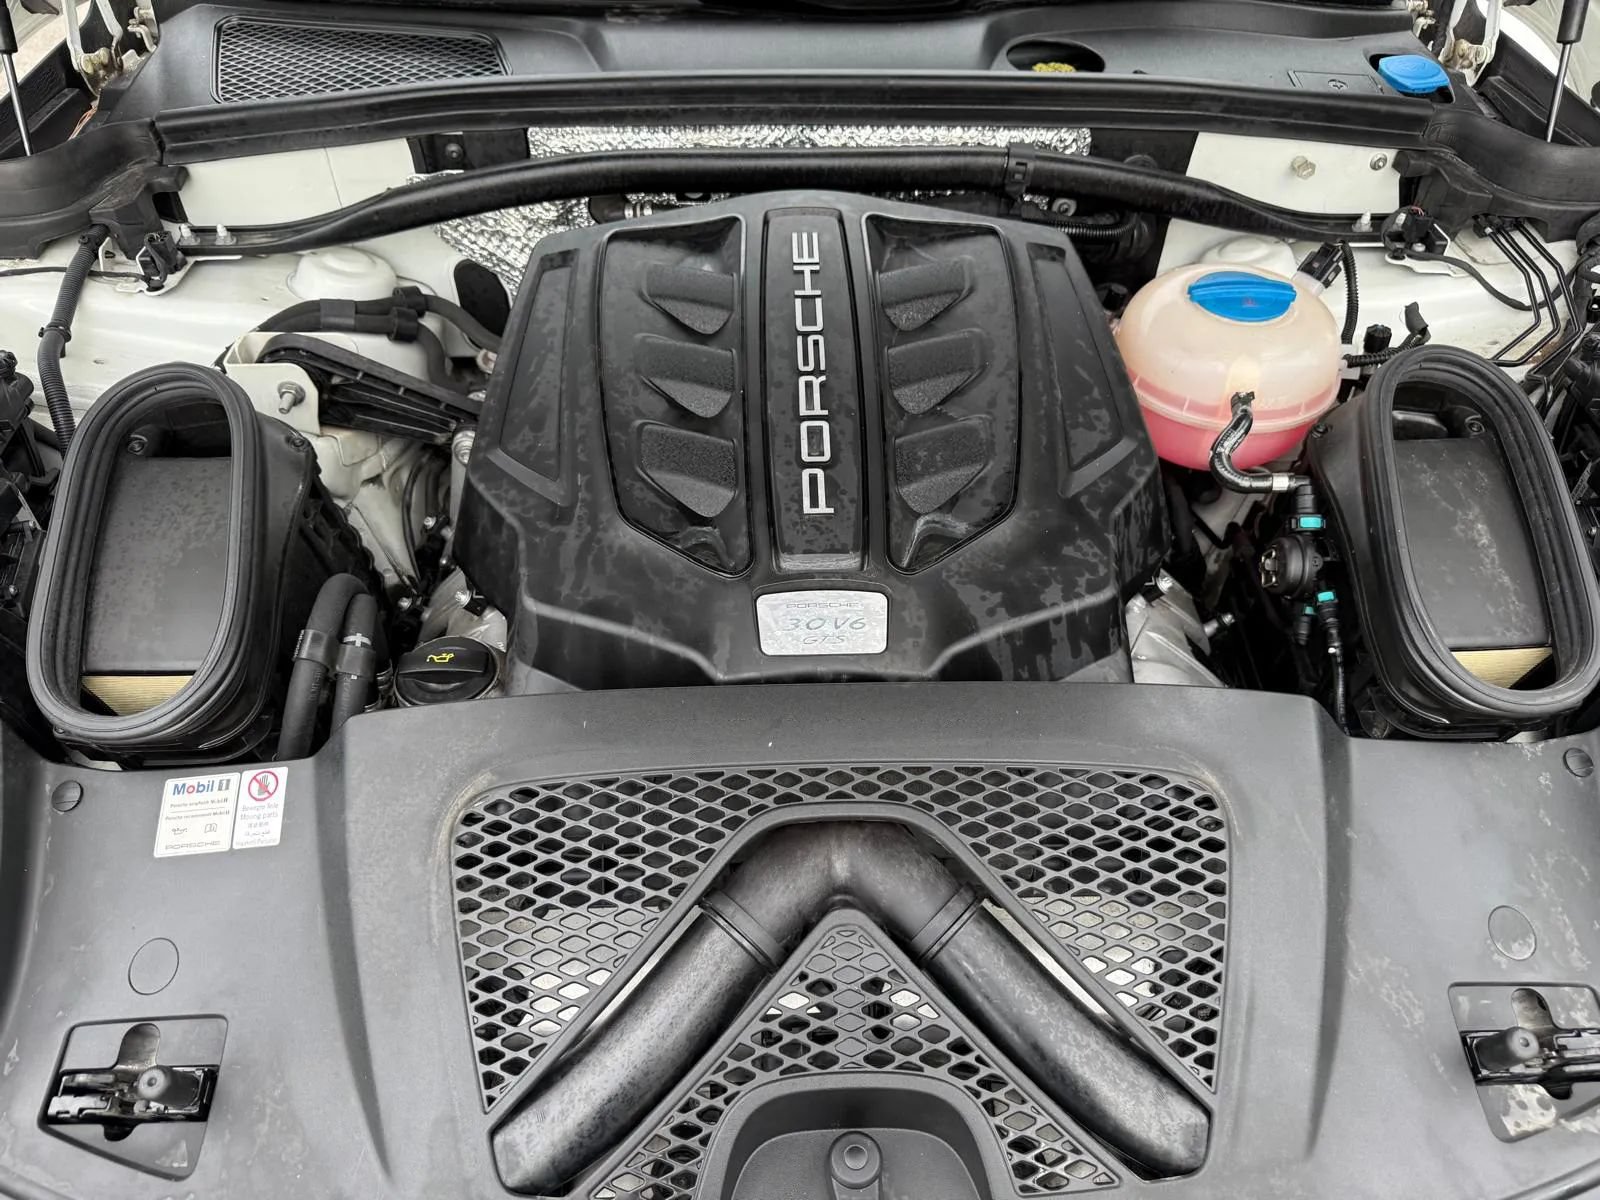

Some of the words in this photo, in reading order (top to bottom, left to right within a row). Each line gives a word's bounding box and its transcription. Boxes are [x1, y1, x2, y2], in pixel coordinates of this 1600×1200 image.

[792, 232, 834, 515] PORSCHE
[834, 617, 866, 631] V6
[173, 780, 215, 796] Mobil
[165, 841, 221, 850] PORSCHE
